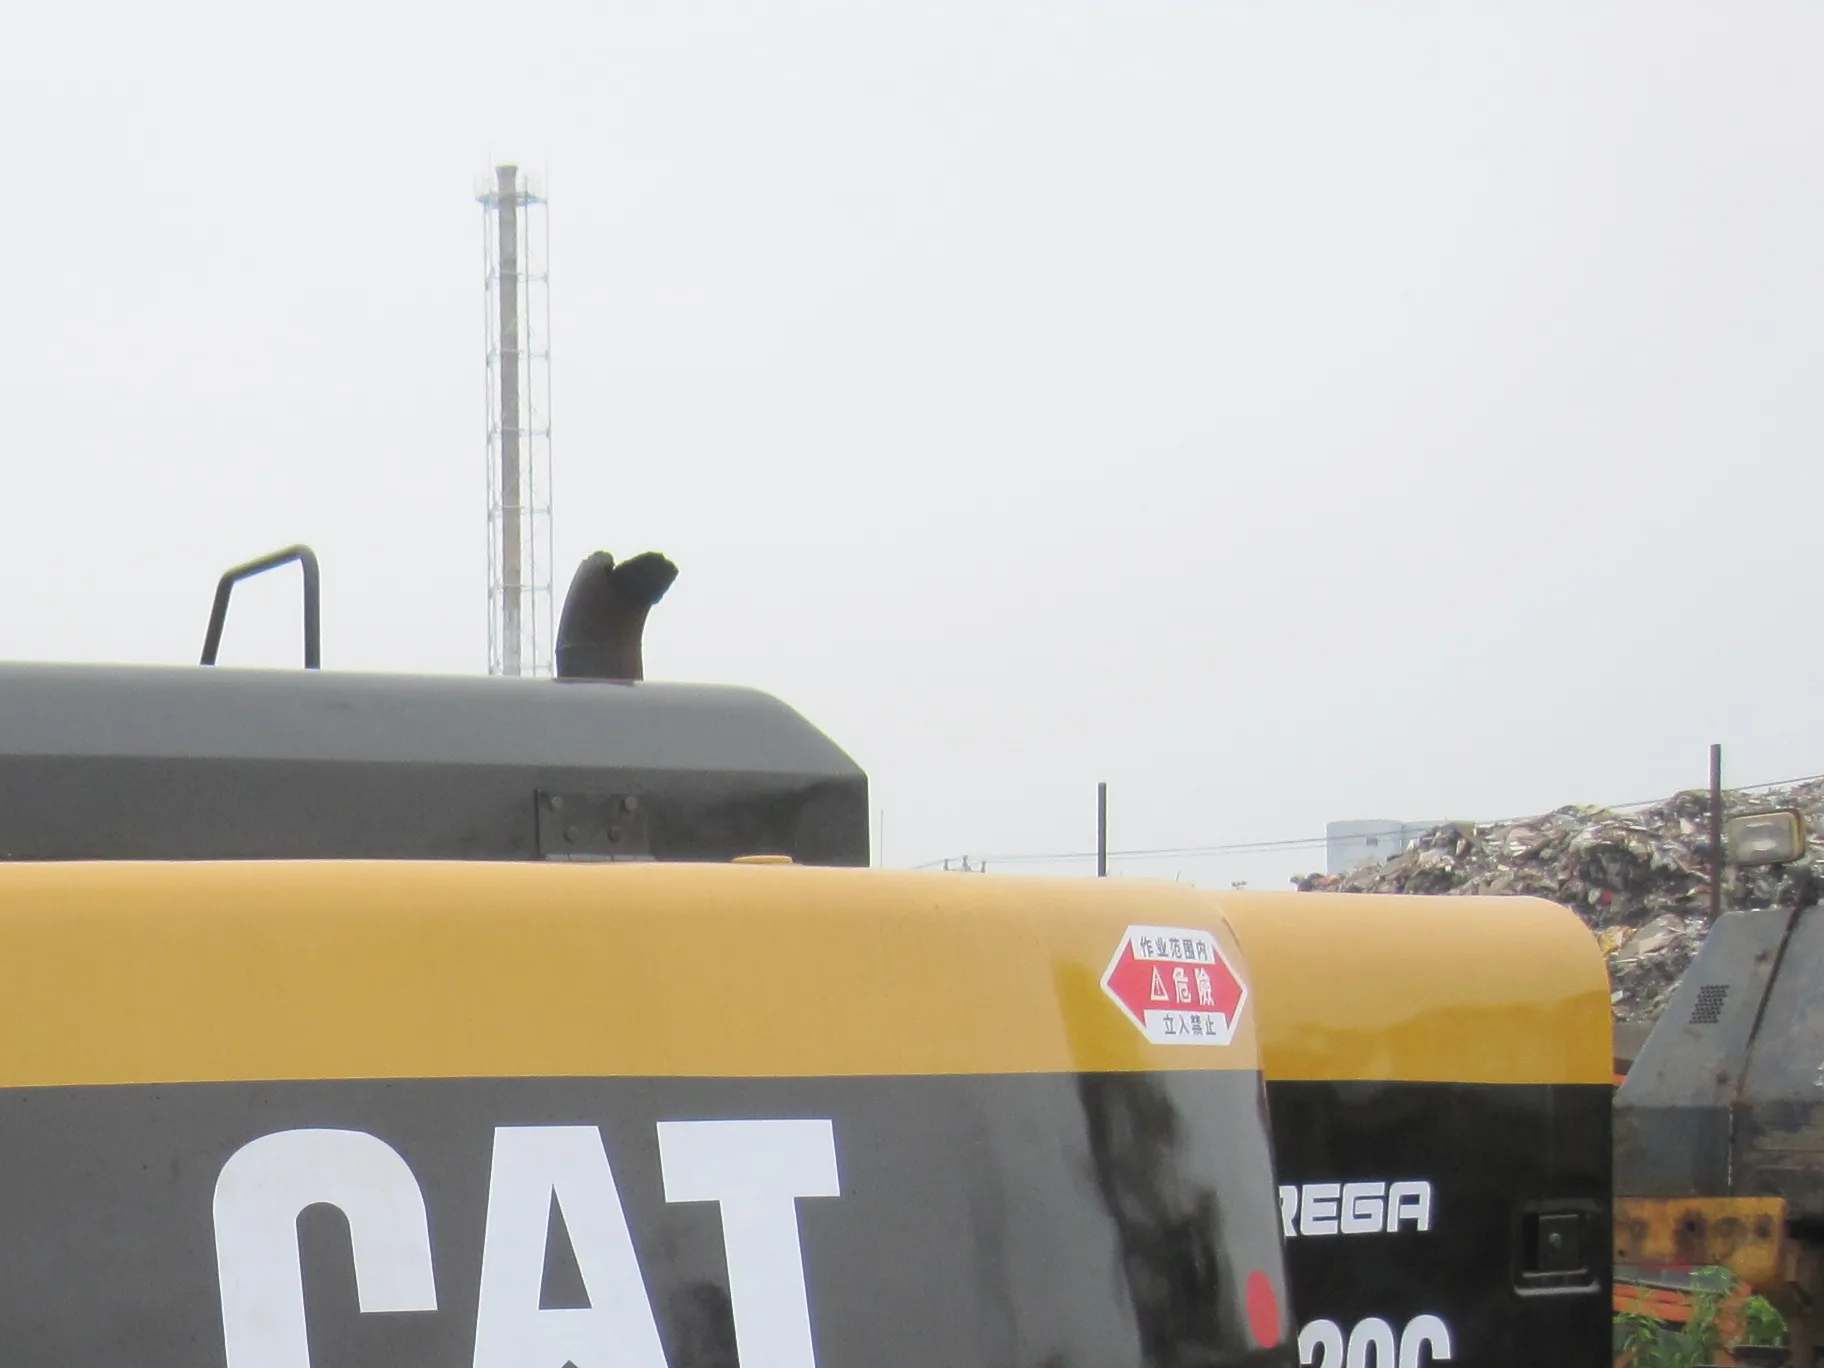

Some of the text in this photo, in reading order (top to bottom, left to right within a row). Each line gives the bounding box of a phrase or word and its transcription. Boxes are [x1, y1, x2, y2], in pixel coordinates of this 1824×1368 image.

[1139, 936, 1208, 962] 作业范围内
[1162, 1013, 1216, 1036] 立入禁止
[1278, 1180, 1431, 1238] REGA
